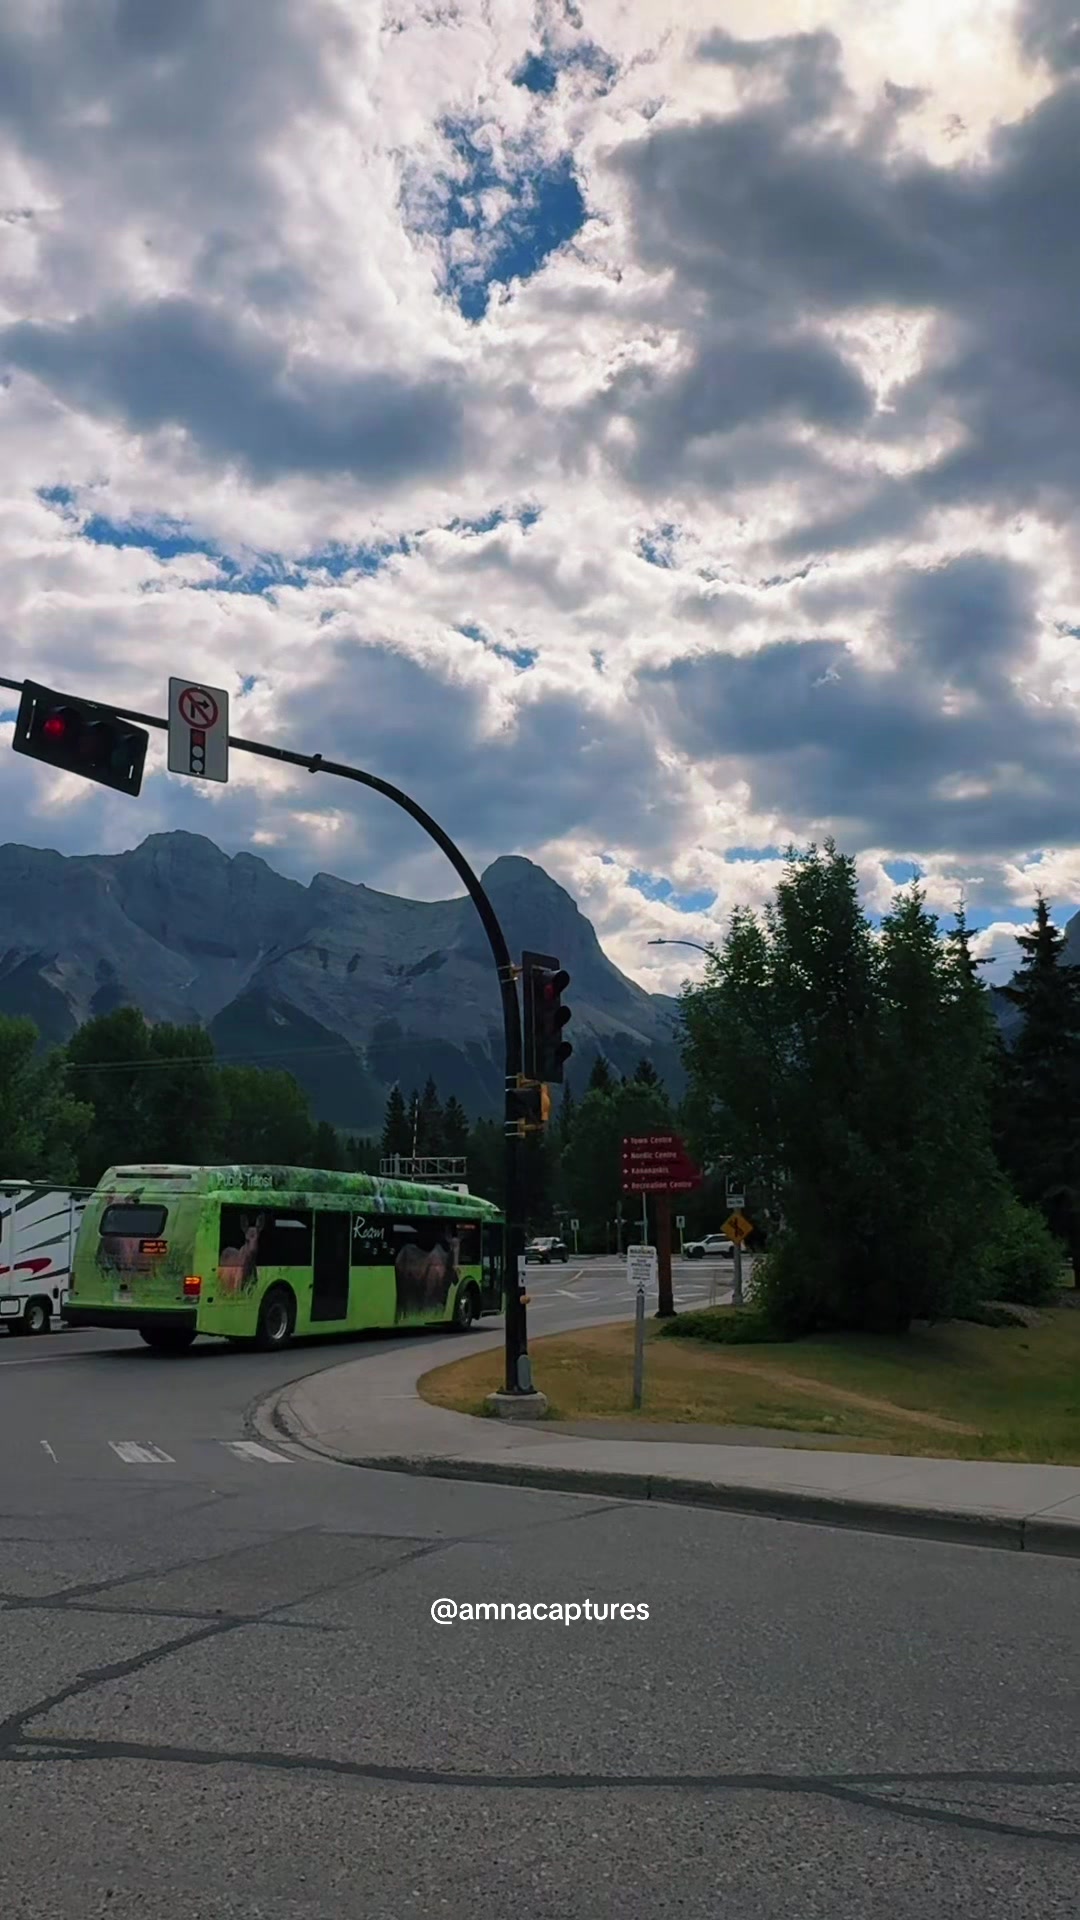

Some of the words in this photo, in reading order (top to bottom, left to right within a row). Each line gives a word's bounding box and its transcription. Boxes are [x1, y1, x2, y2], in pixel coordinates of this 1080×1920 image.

[650, 1136, 672, 1144] Centre
[630, 1151, 653, 1159] Nordic
[216, 1172, 243, 1187] Public
[353, 1215, 385, 1240] Roam
